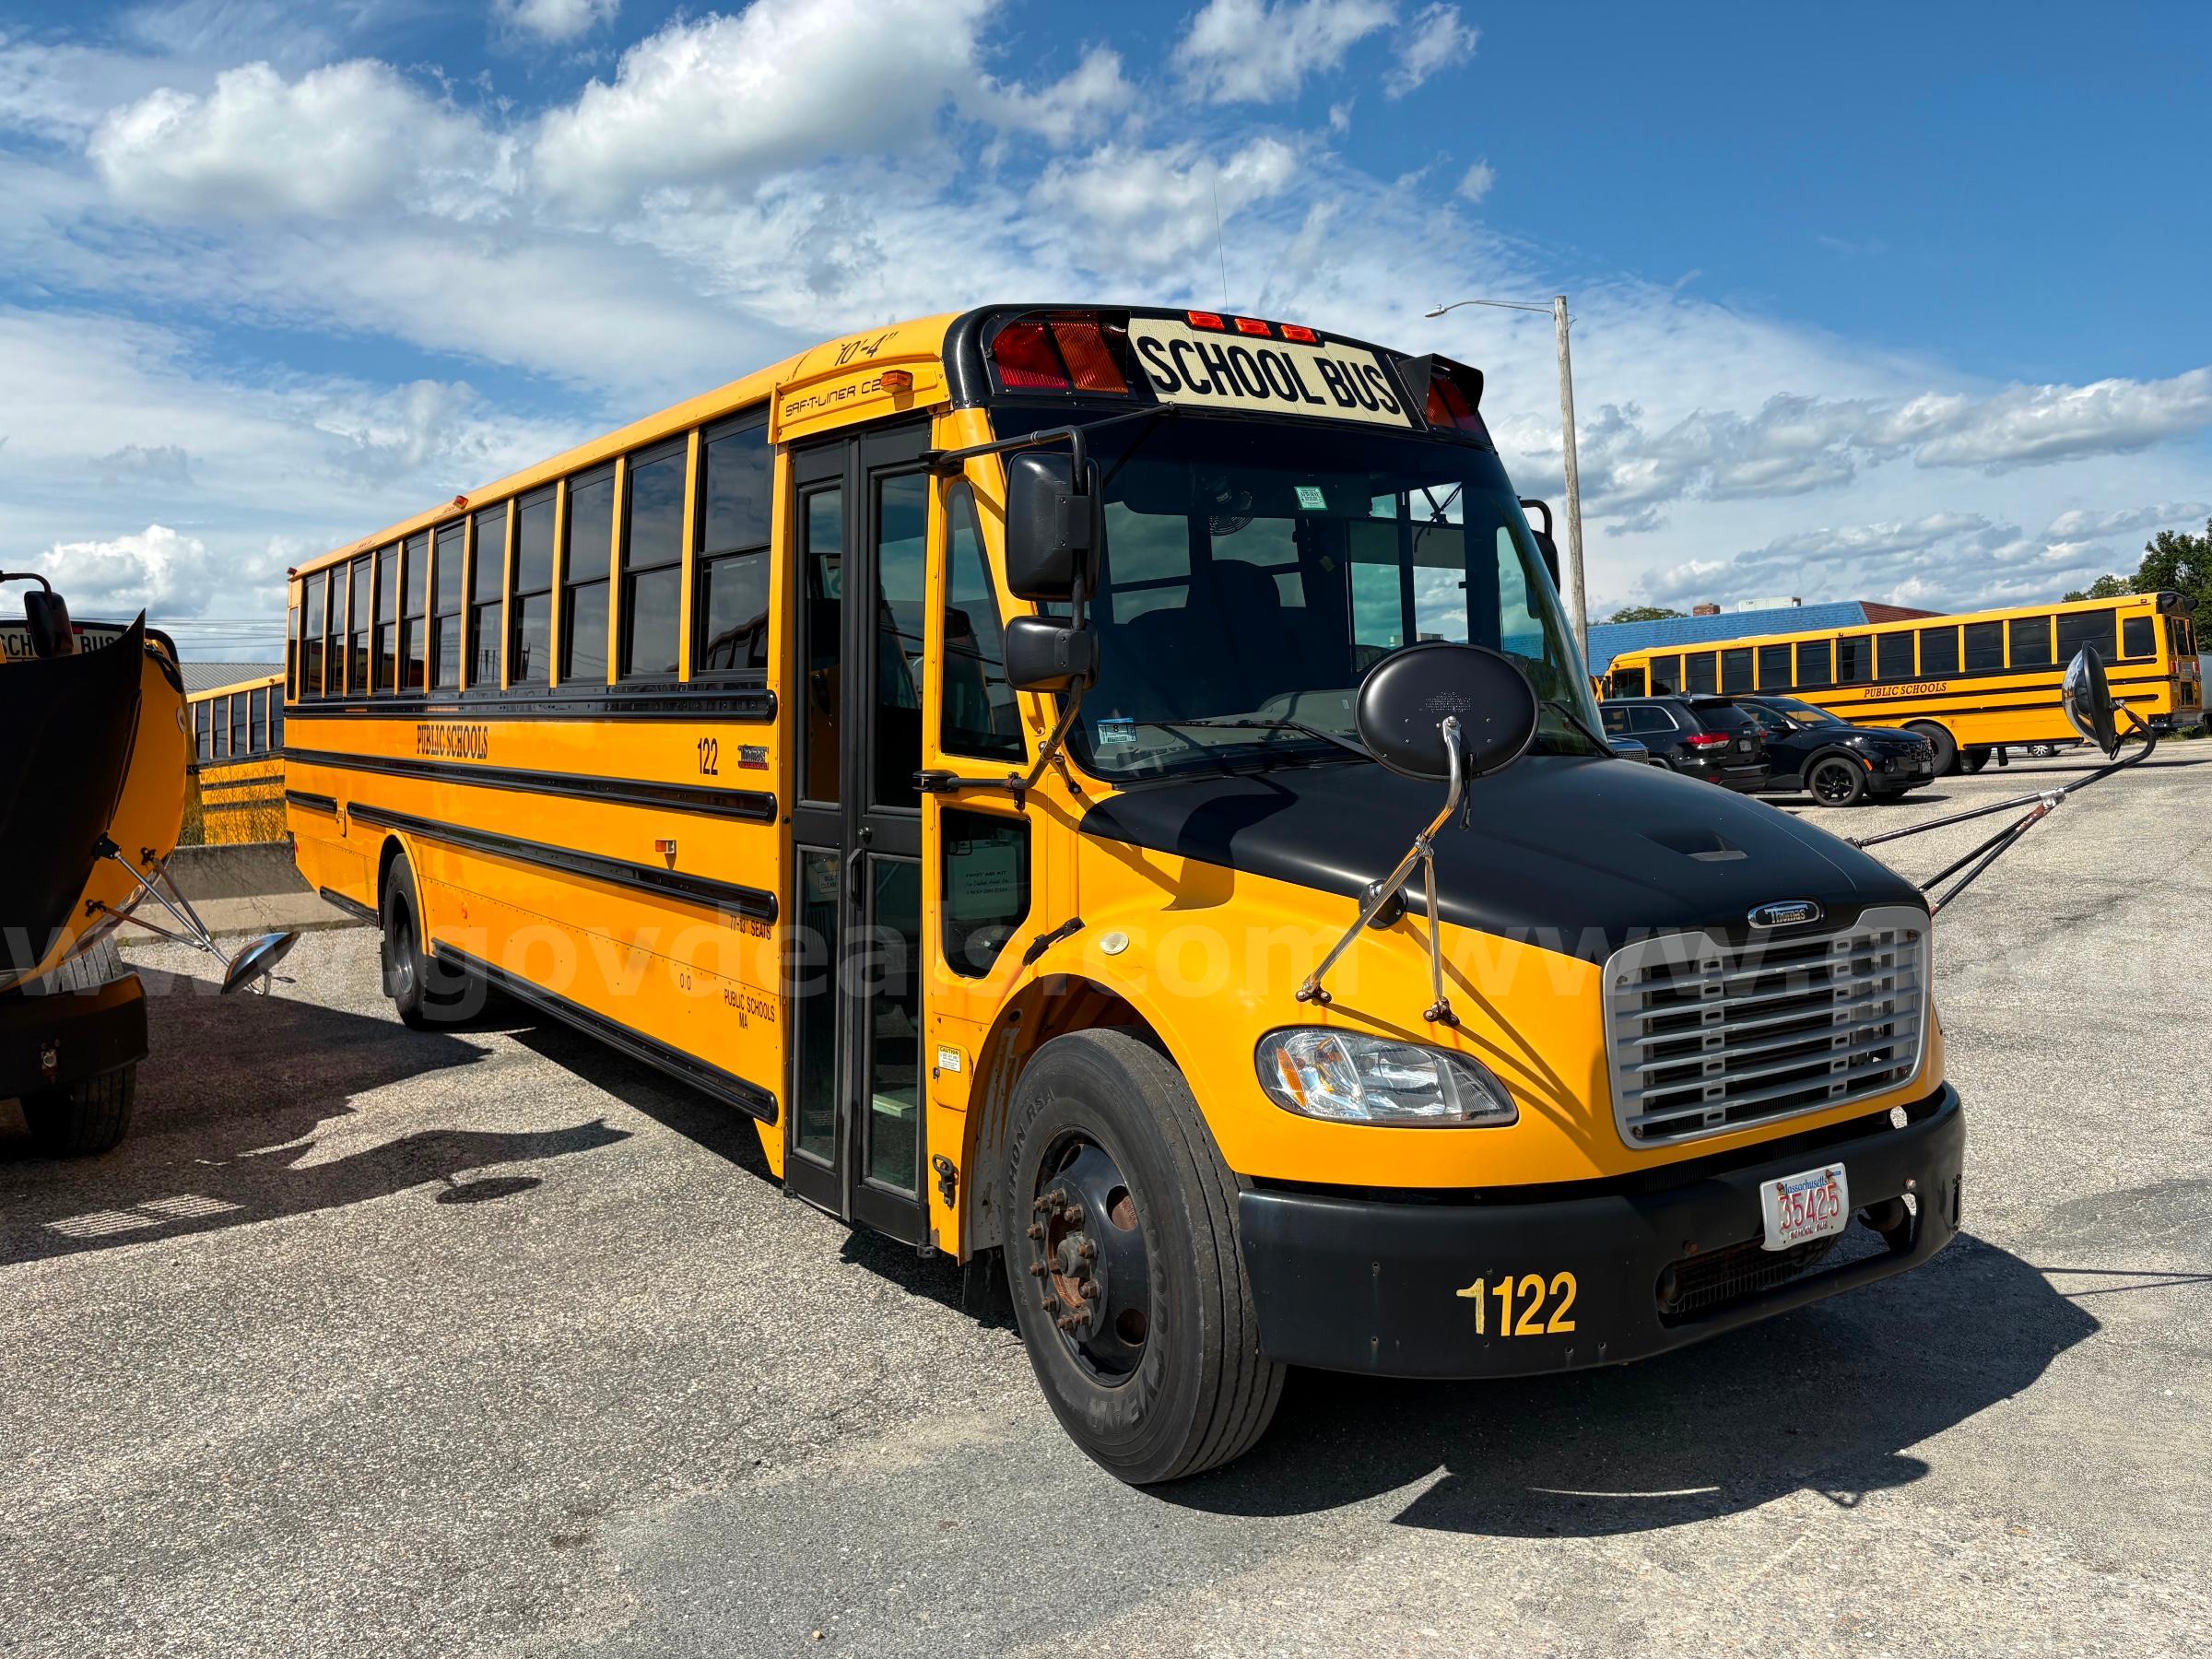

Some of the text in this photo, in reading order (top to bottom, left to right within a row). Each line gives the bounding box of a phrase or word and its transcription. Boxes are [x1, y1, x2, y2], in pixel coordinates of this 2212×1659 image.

[1136, 335, 1401, 415] SCHOOL BUS
[1864, 682, 1947, 698] PUBLIC SCHOOLS
[417, 724, 488, 759] PUBLIC SCHOOLS
[697, 736, 718, 776] 122
[750, 920, 771, 940] SEATS
[1764, 904, 1808, 924] Thomas
[724, 988, 775, 1022] PUBLIC SCHOOLS
[738, 1012, 748, 1030] MA
[1778, 1182, 1840, 1230] 35425
[1455, 1271, 1577, 1337] 1122
